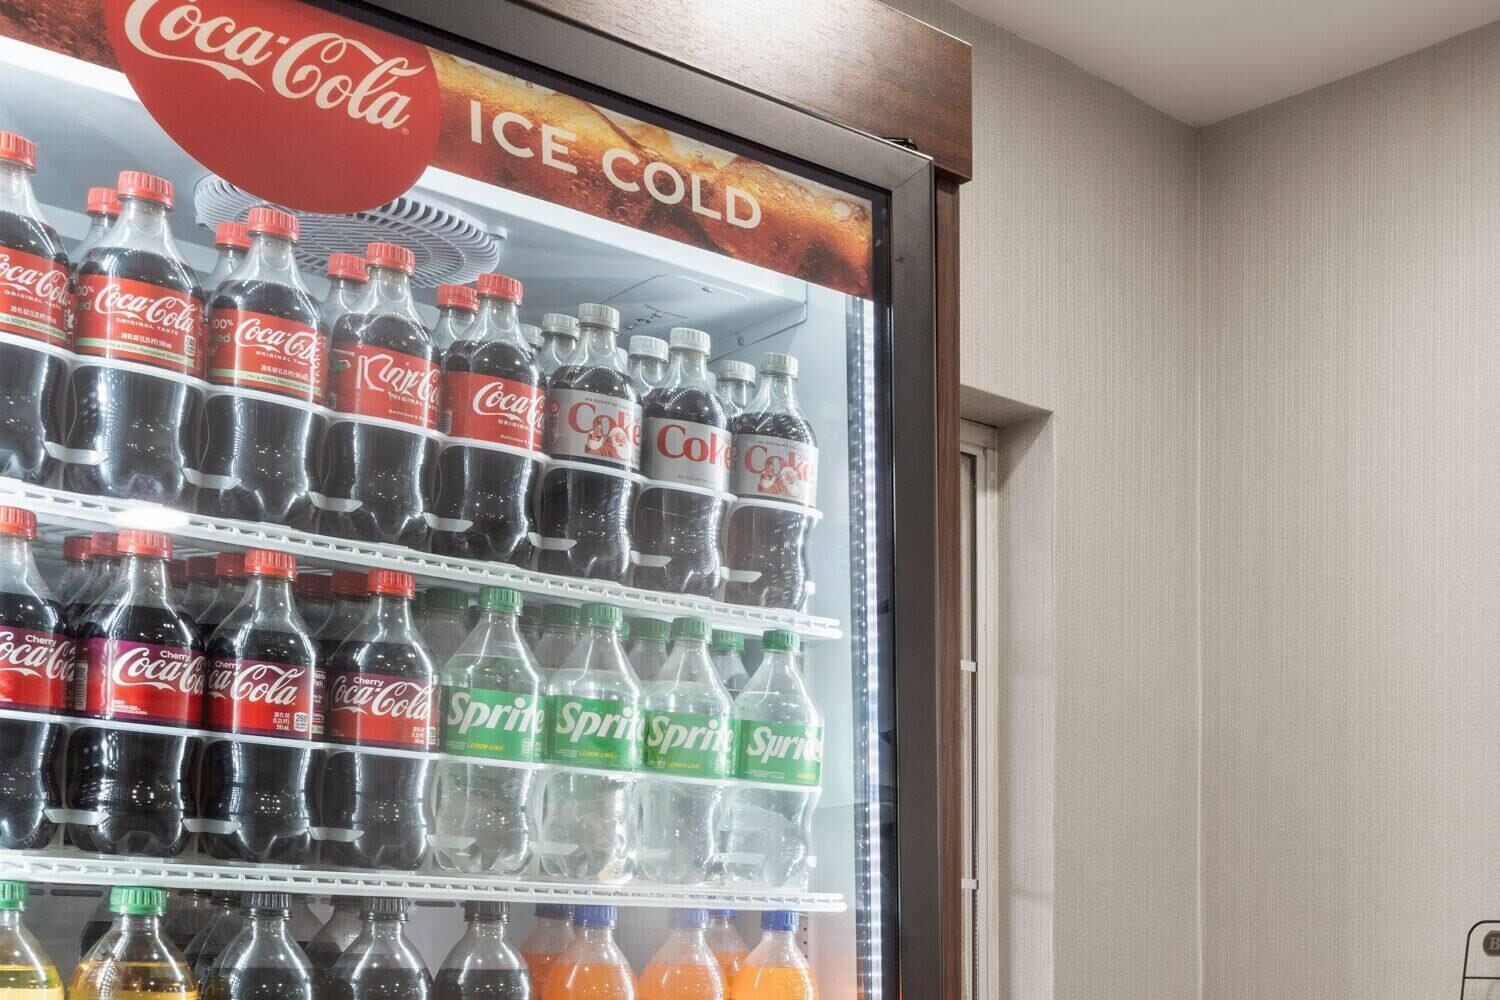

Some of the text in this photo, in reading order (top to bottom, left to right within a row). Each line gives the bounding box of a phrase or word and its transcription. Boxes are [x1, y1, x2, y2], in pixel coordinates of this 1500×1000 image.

[125, 0, 426, 129] Coca-Cola
[470, 100, 762, 230] ICE COLD
[95, 284, 197, 332] Coca-Cola
[115, 317, 179, 336] ORIGINAL TASTE
[256, 350, 291, 362] ORIGINAL
[568, 402, 641, 447] Coke
[657, 424, 735, 471] Coke
[25, 634, 57, 648] Cherry
[160, 650, 191, 663] Cherry
[208, 664, 306, 706] ca-Cola
[215, 660, 242, 671] Cherry
[353, 676, 384, 688] Cherry
[295, 713, 308, 723] 260
[333, 676, 433, 720] Coca-Cola
[448, 692, 545, 734] Sprite
